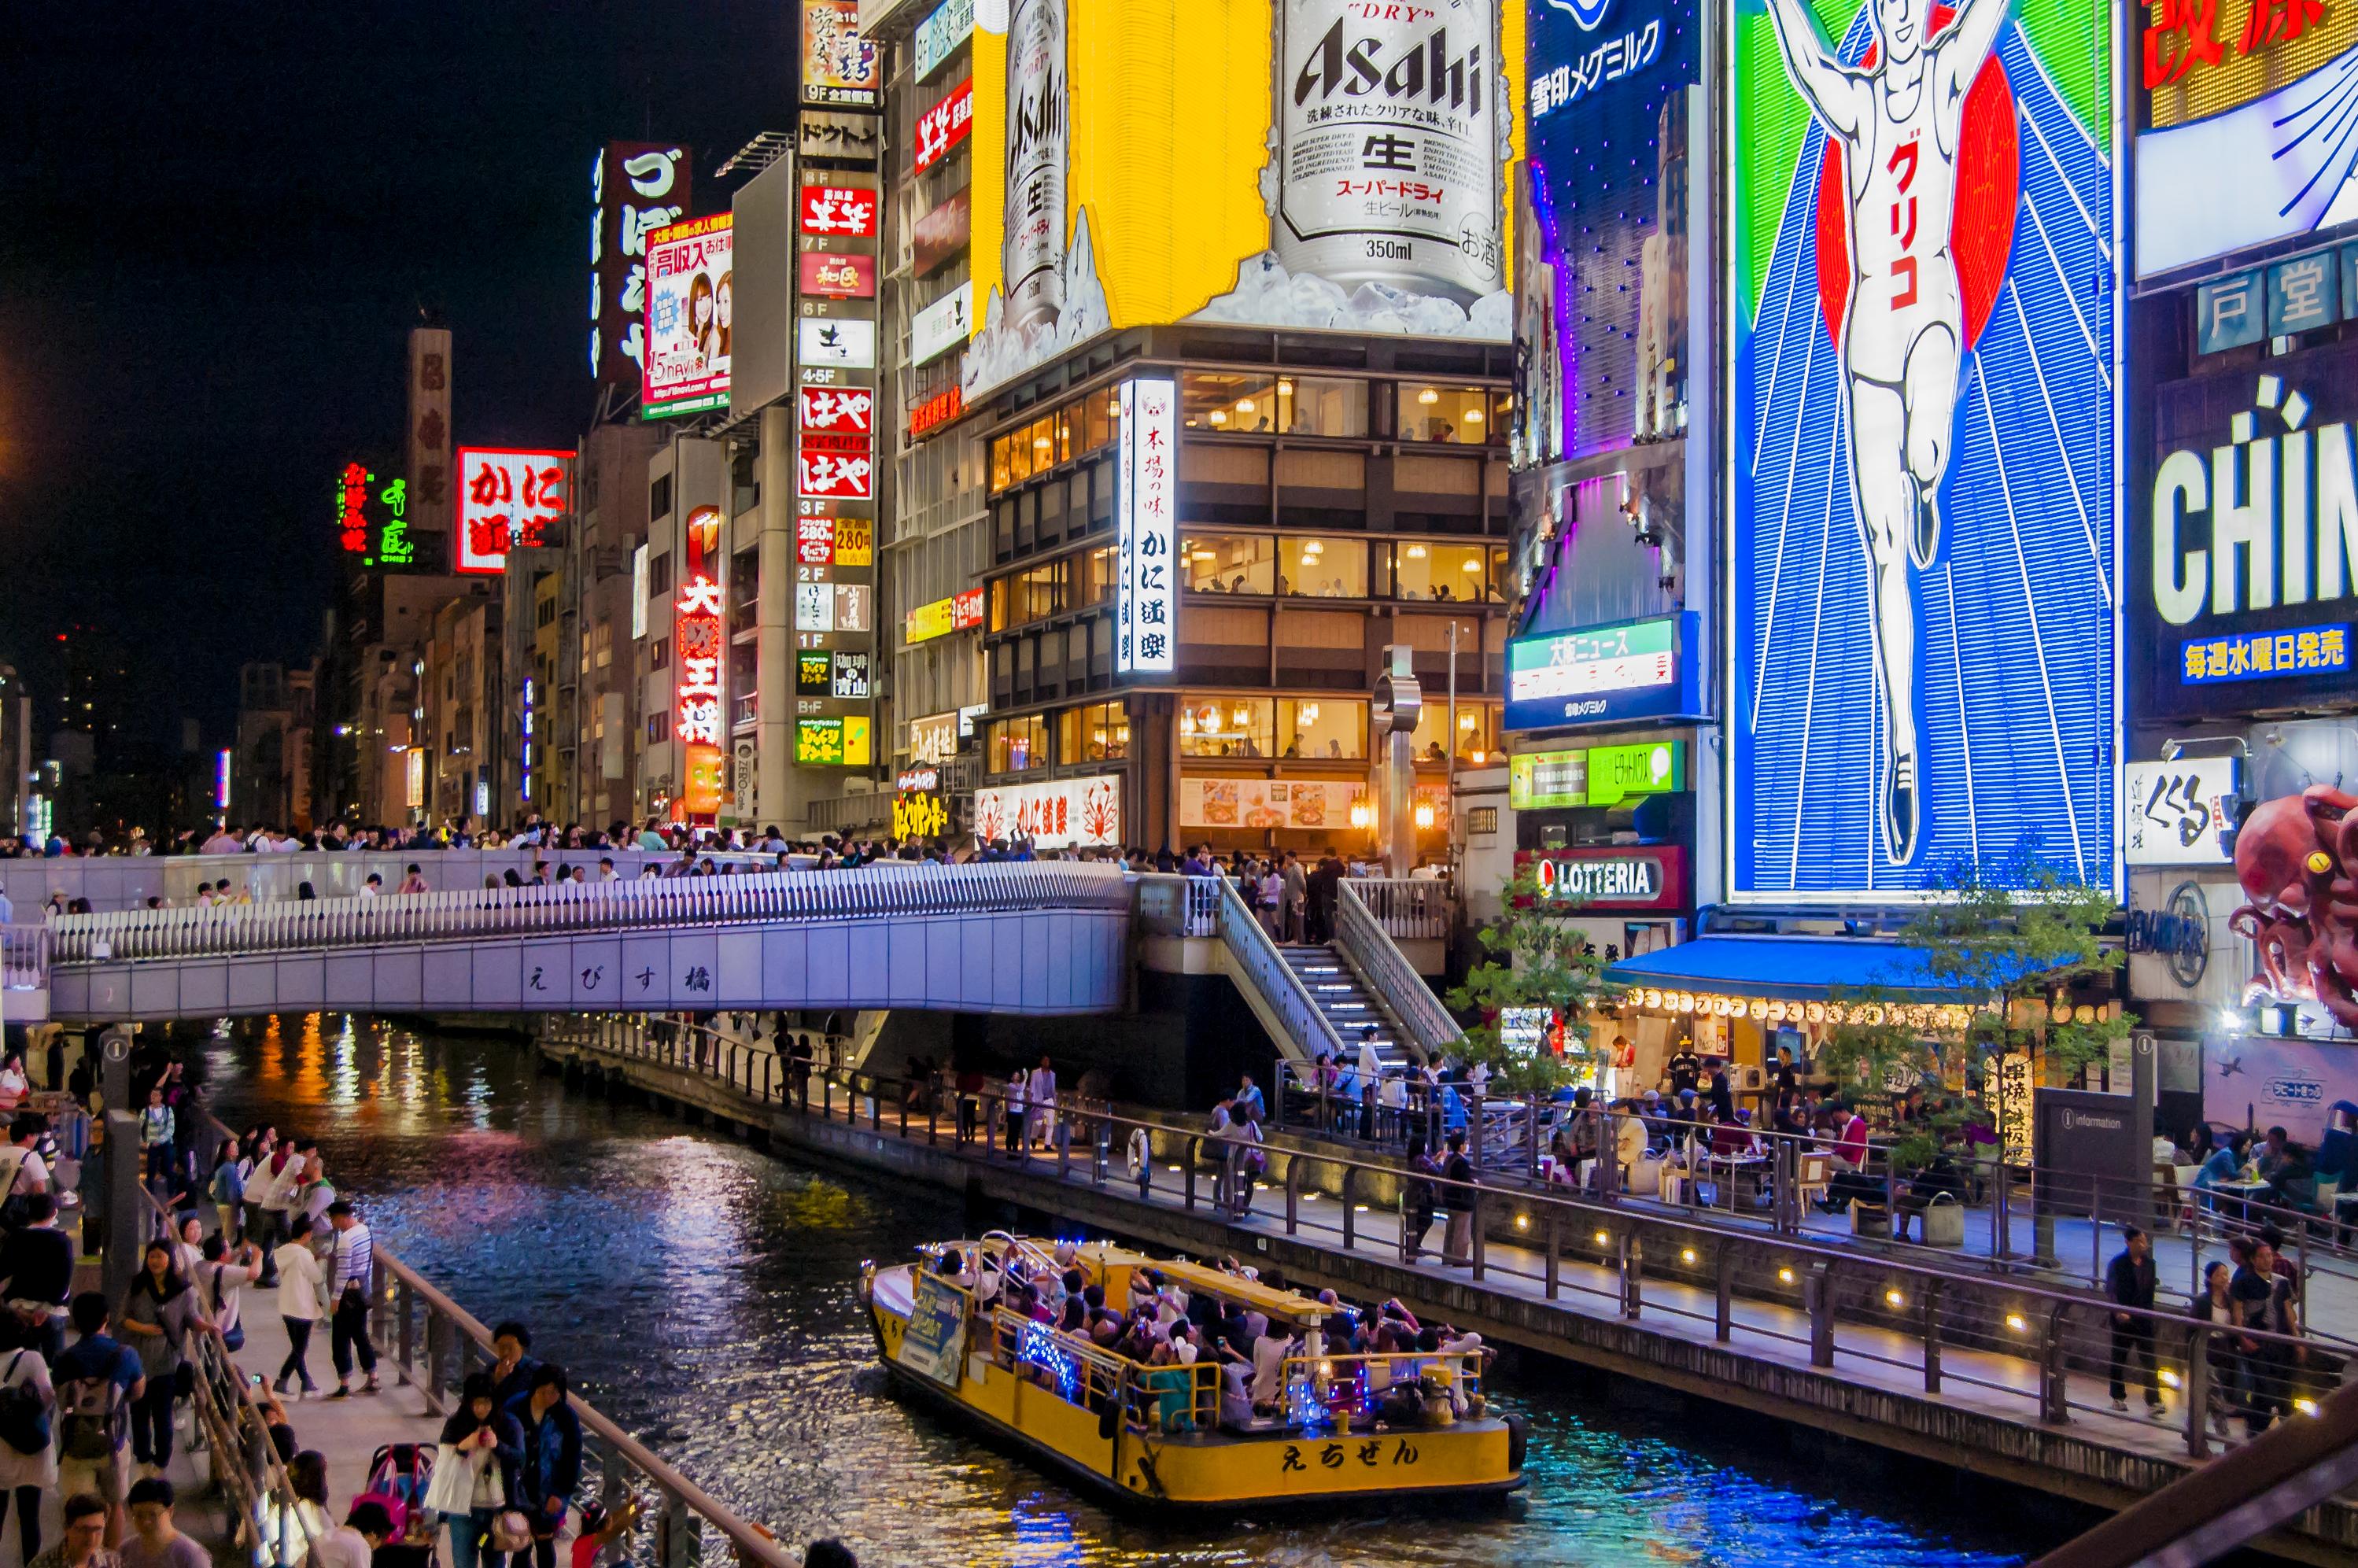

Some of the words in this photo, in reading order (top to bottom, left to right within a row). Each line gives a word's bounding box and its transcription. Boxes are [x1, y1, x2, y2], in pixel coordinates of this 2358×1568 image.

[1294, 17, 1482, 119] Asahi
[1531, 19, 1659, 118] 雪印メグミルク
[808, 85, 827, 100] 9F
[1009, 61, 1062, 180] Asahi
[1362, 134, 1416, 172] 生
[1336, 179, 1444, 204] スーパードライ
[805, 198, 870, 234] 笑笑
[1886, 127, 1921, 312] グリコ
[656, 242, 708, 279] 高収入
[1366, 240, 1413, 261] 350ml
[816, 265, 859, 288] 和民
[803, 391, 871, 429] はや
[469, 462, 566, 511] かに
[802, 455, 870, 493] はや
[1143, 426, 1165, 519] 本場の味
[836, 529, 871, 550] 280円
[836, 653, 867, 669] 珈琲
[1550, 630, 1629, 667] 大阪ニュース
[2185, 629, 2345, 679] 毎週水曜日発売
[836, 677, 867, 695] 青山
[846, 668, 858, 680] の
[799, 743, 842, 761] ドンキー
[801, 726, 840, 746] びっくり
[2145, 774, 2209, 847] くくる
[1559, 862, 1651, 895] LOTTERIA
[530, 965, 710, 993] えびす橋
[2076, 1114, 2121, 1130] information
[1283, 1438, 1419, 1473] えちぜん
